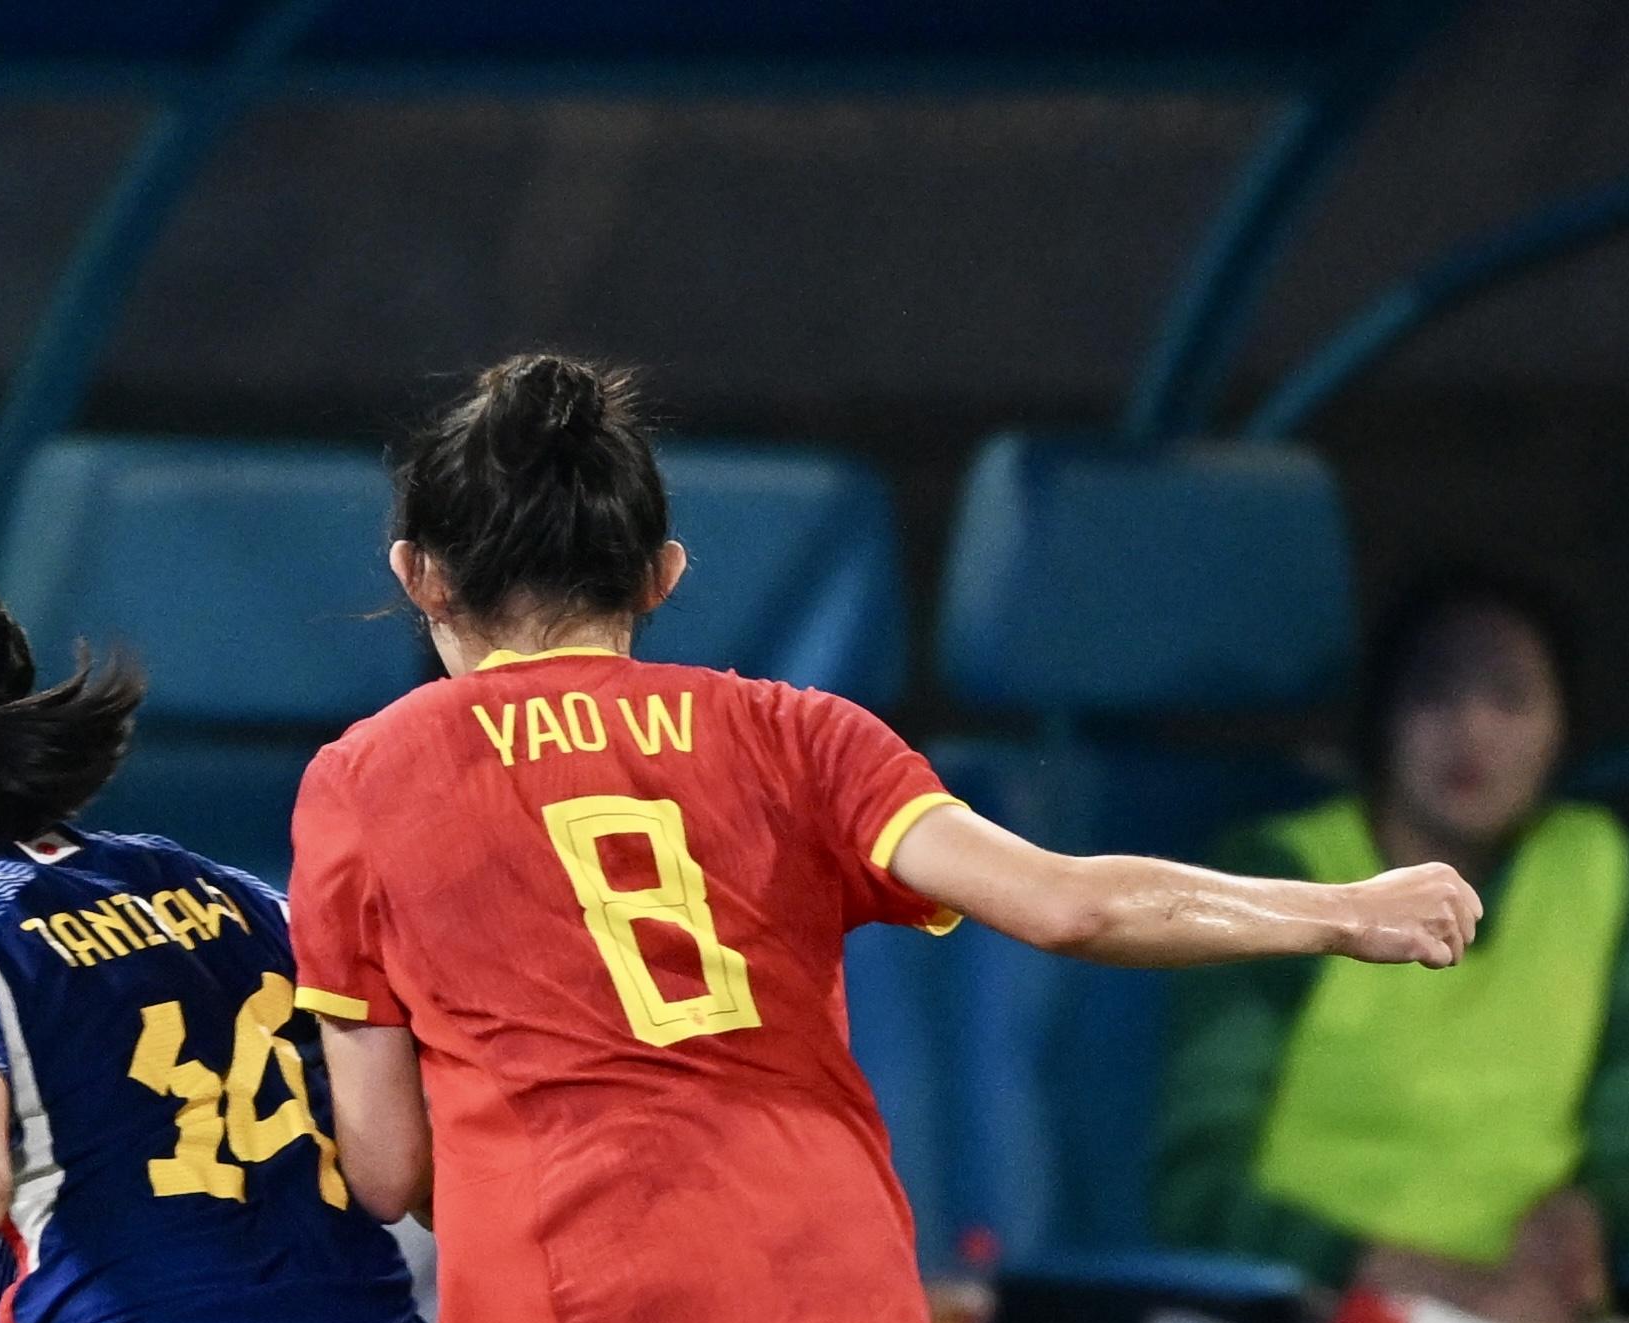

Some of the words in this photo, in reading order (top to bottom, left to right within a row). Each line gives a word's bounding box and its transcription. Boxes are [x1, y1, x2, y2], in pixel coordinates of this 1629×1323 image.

[472, 691, 608, 767] YAO
[617, 691, 693, 756] W
[541, 795, 763, 1048] 8
[128, 972, 350, 1210] 14
